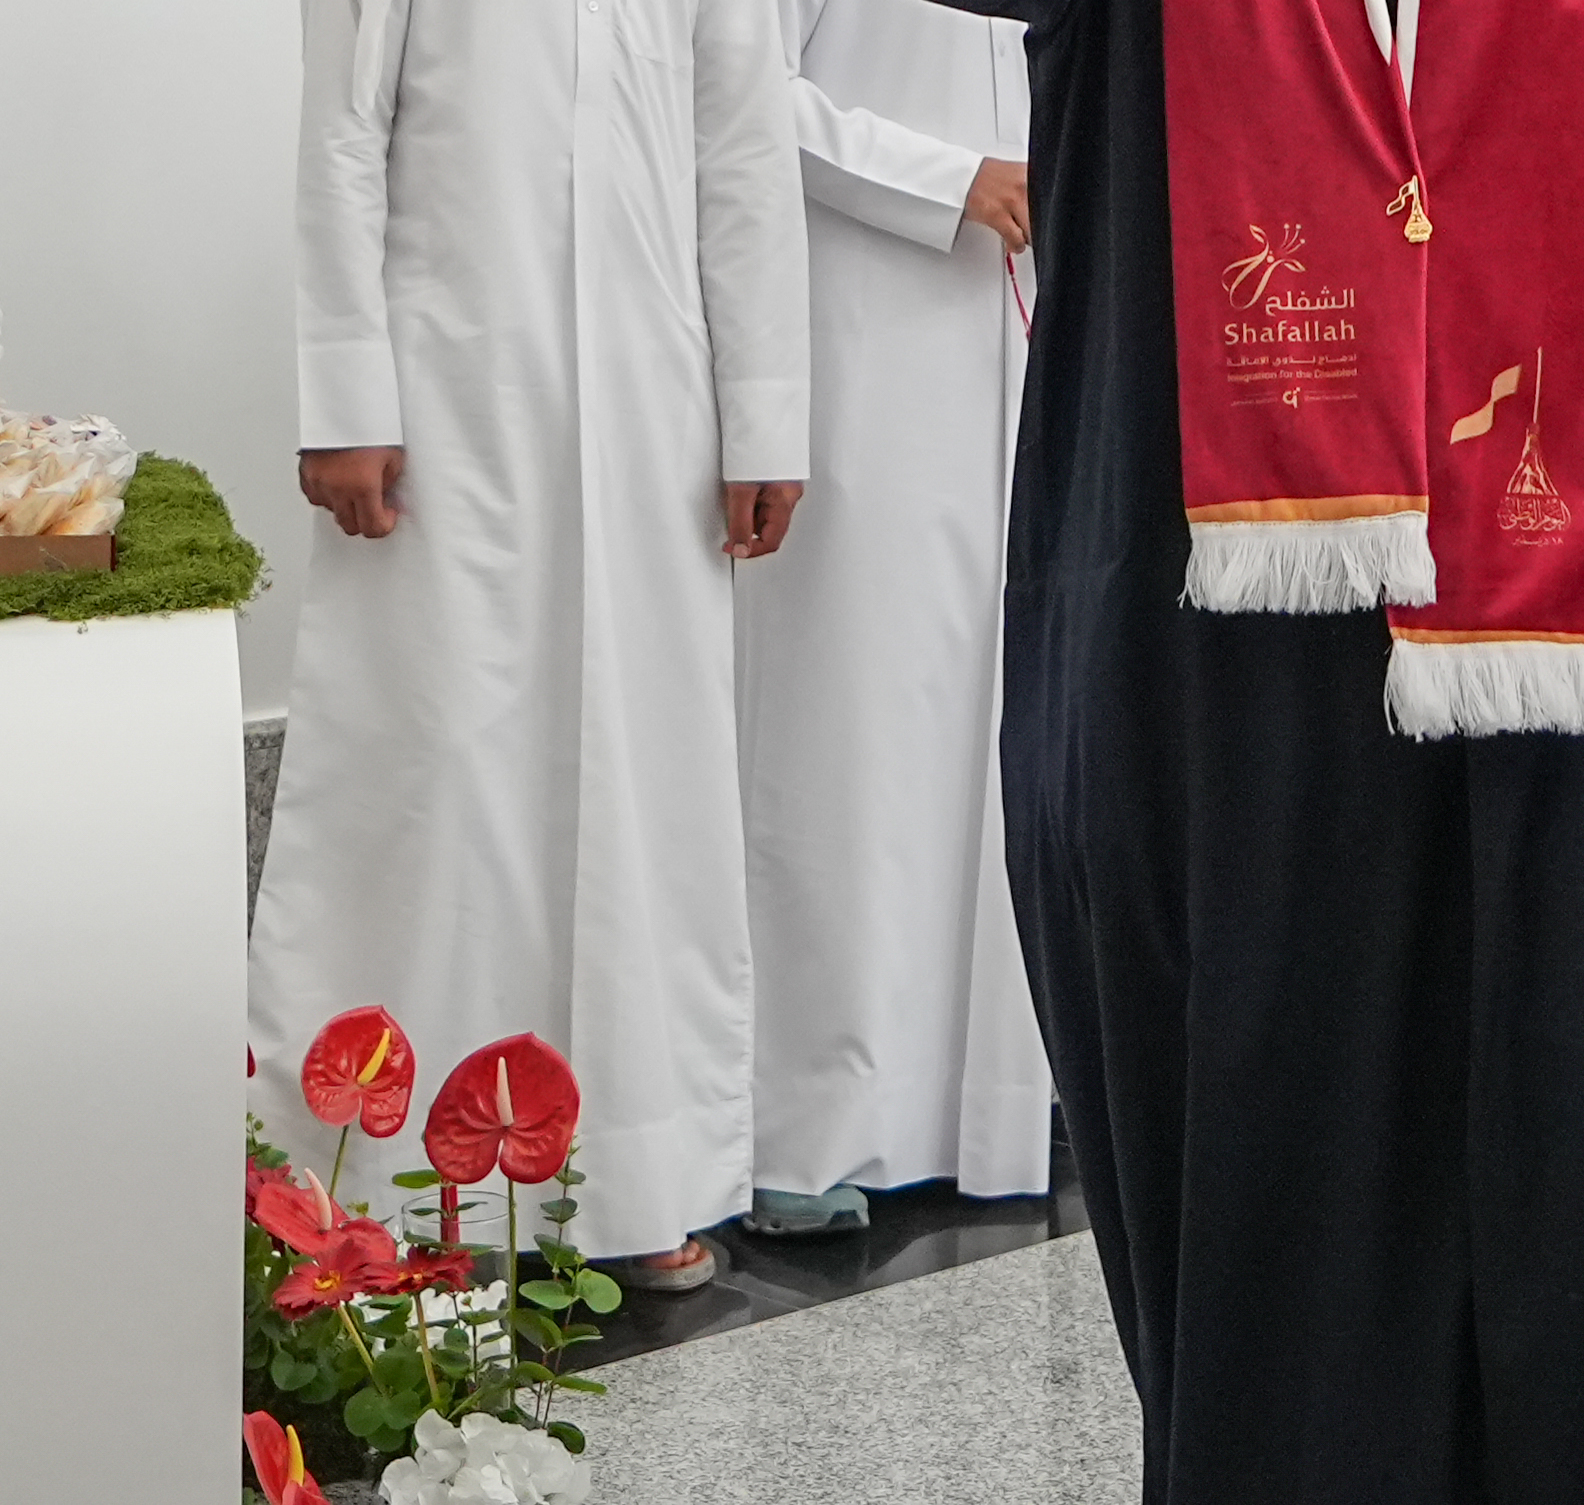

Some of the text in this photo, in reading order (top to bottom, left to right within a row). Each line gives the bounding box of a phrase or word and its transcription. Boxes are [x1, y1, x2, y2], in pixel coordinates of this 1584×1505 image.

[1265, 285, 1355, 316] الشفلح
[1224, 319, 1356, 346] Shafallah
[1227, 367, 1358, 383] Integration for the Disabled
